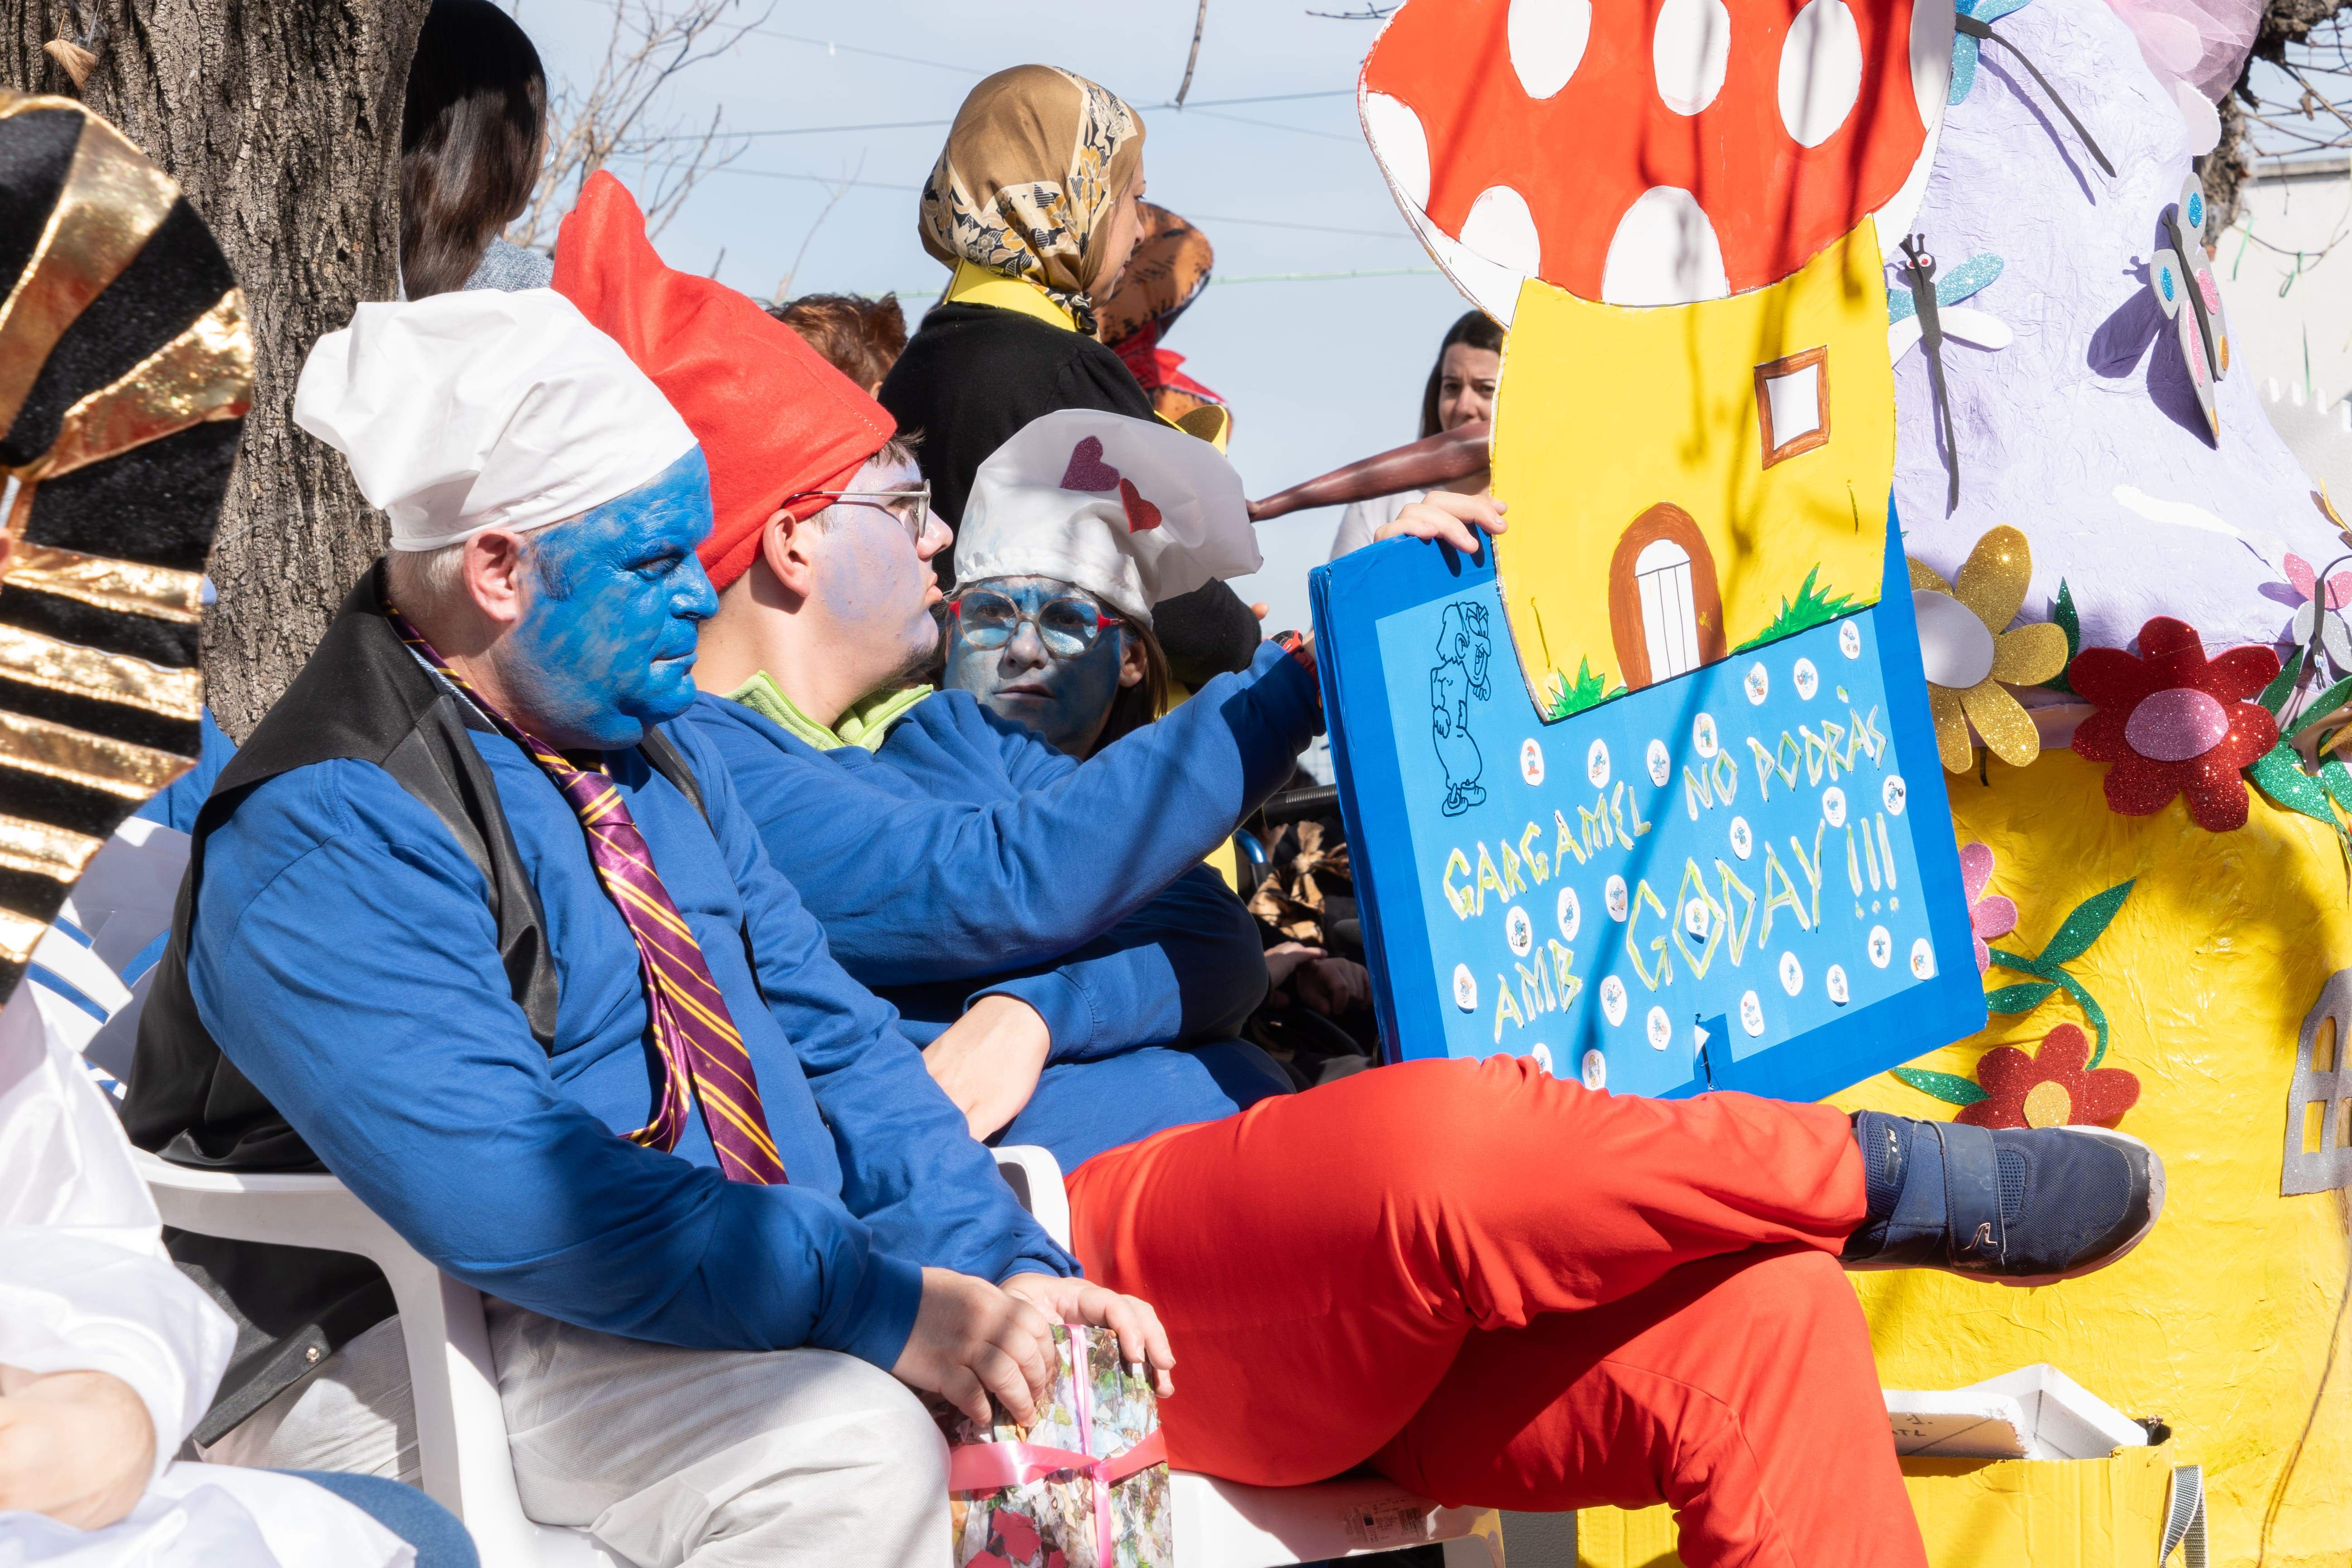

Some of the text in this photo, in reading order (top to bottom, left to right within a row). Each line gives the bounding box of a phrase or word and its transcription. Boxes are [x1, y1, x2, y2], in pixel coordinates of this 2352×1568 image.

[1443, 781, 1651, 920] GARGAMEL
[1683, 748, 1738, 821] NO
[1494, 938, 1583, 1044] AMB
